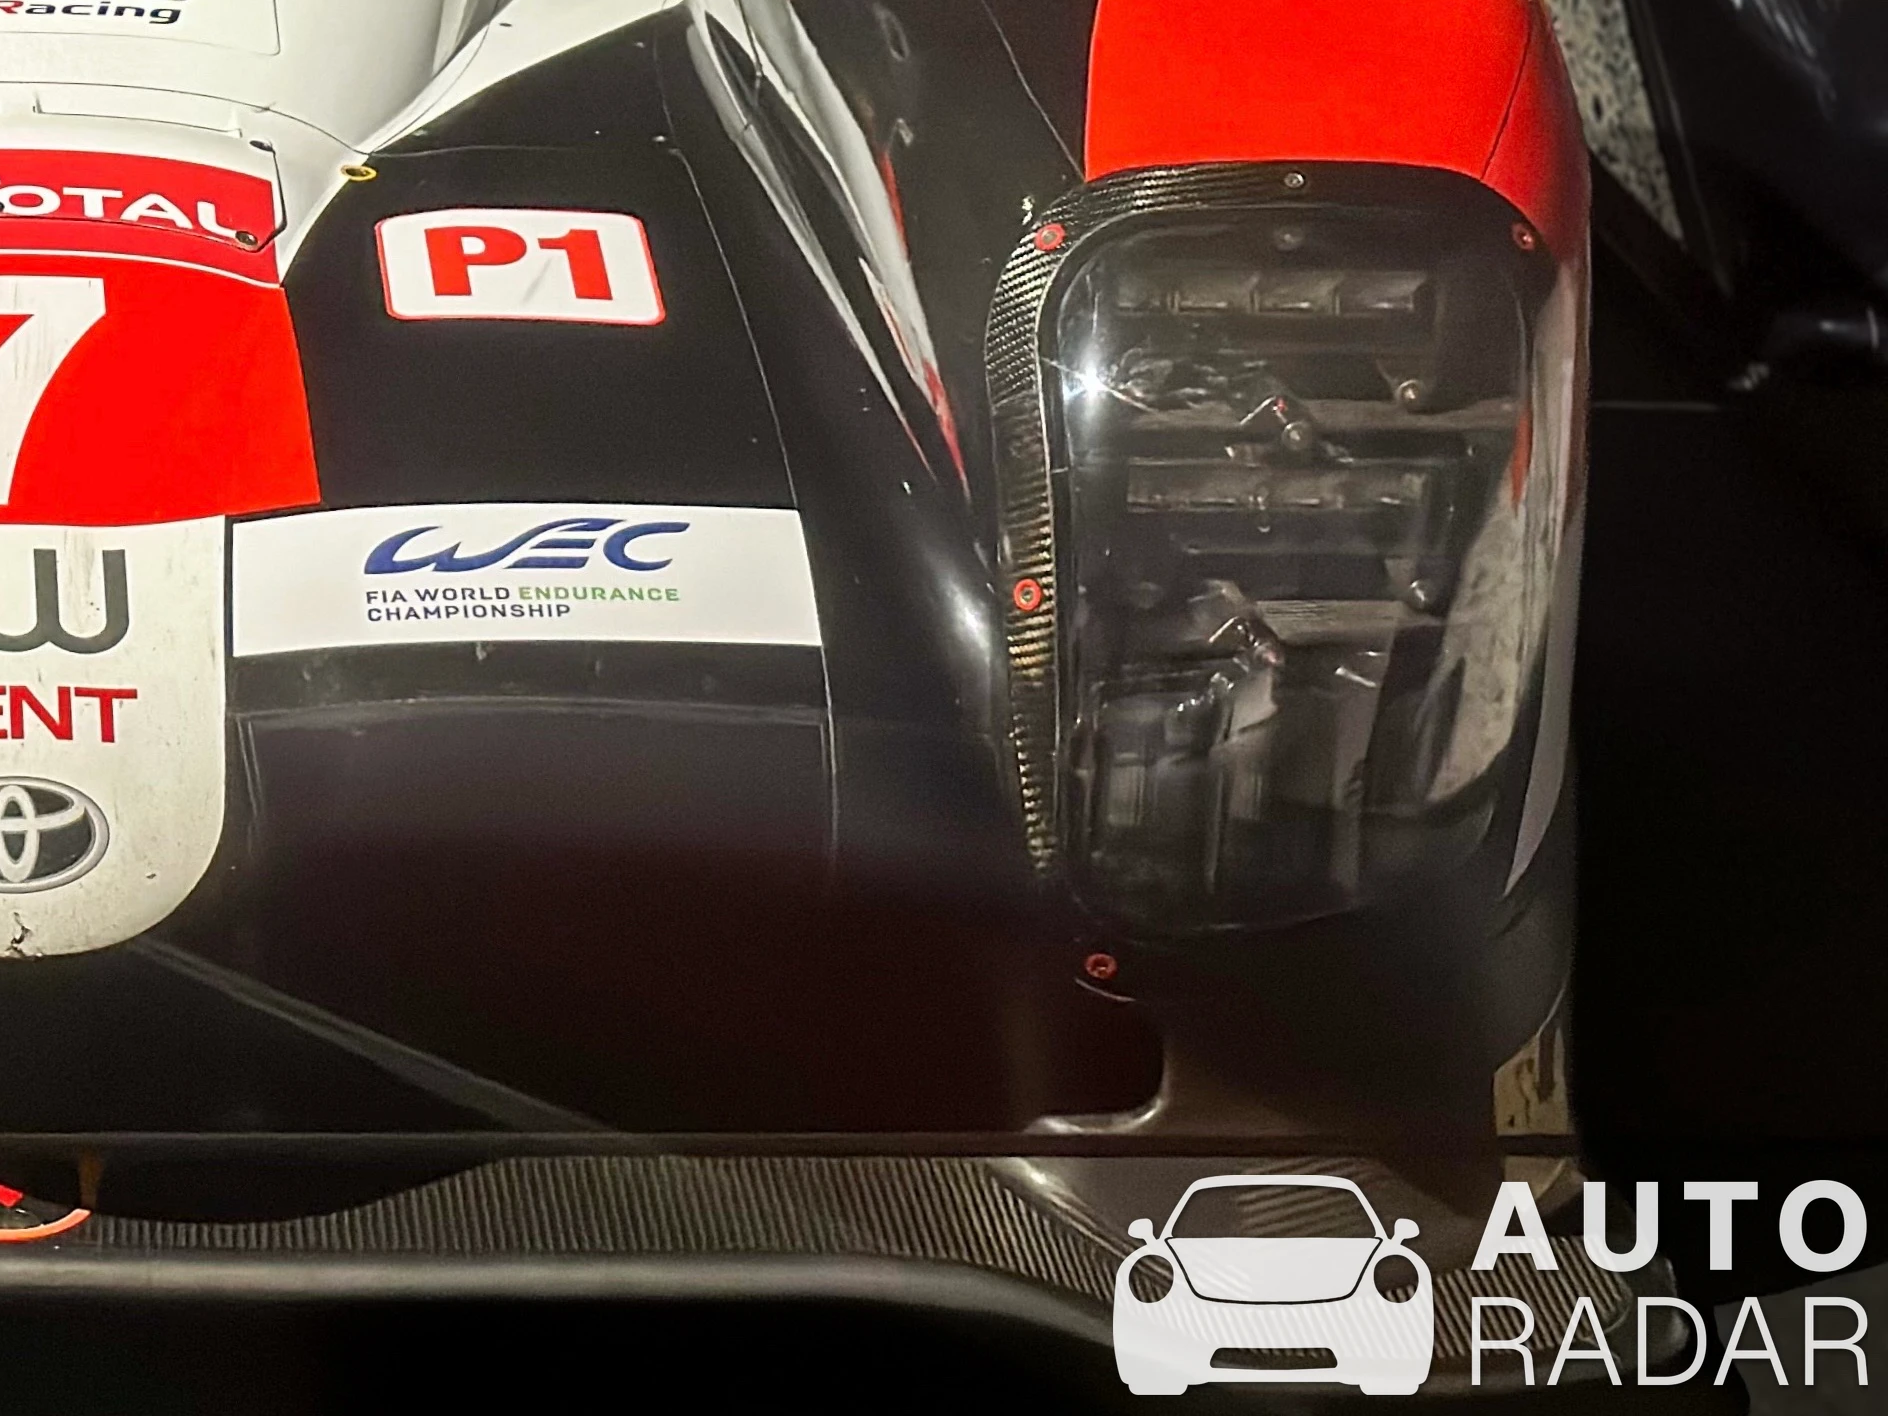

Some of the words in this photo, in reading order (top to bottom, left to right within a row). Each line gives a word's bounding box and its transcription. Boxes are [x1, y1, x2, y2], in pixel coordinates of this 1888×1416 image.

[425, 224, 615, 303] P1
[364, 517, 690, 575] WEC
[365, 588, 407, 605] FIA
[414, 586, 511, 603] WORLD
[518, 586, 680, 603] ENDURANCE
[367, 603, 571, 623] CHAMPIONSHIP
